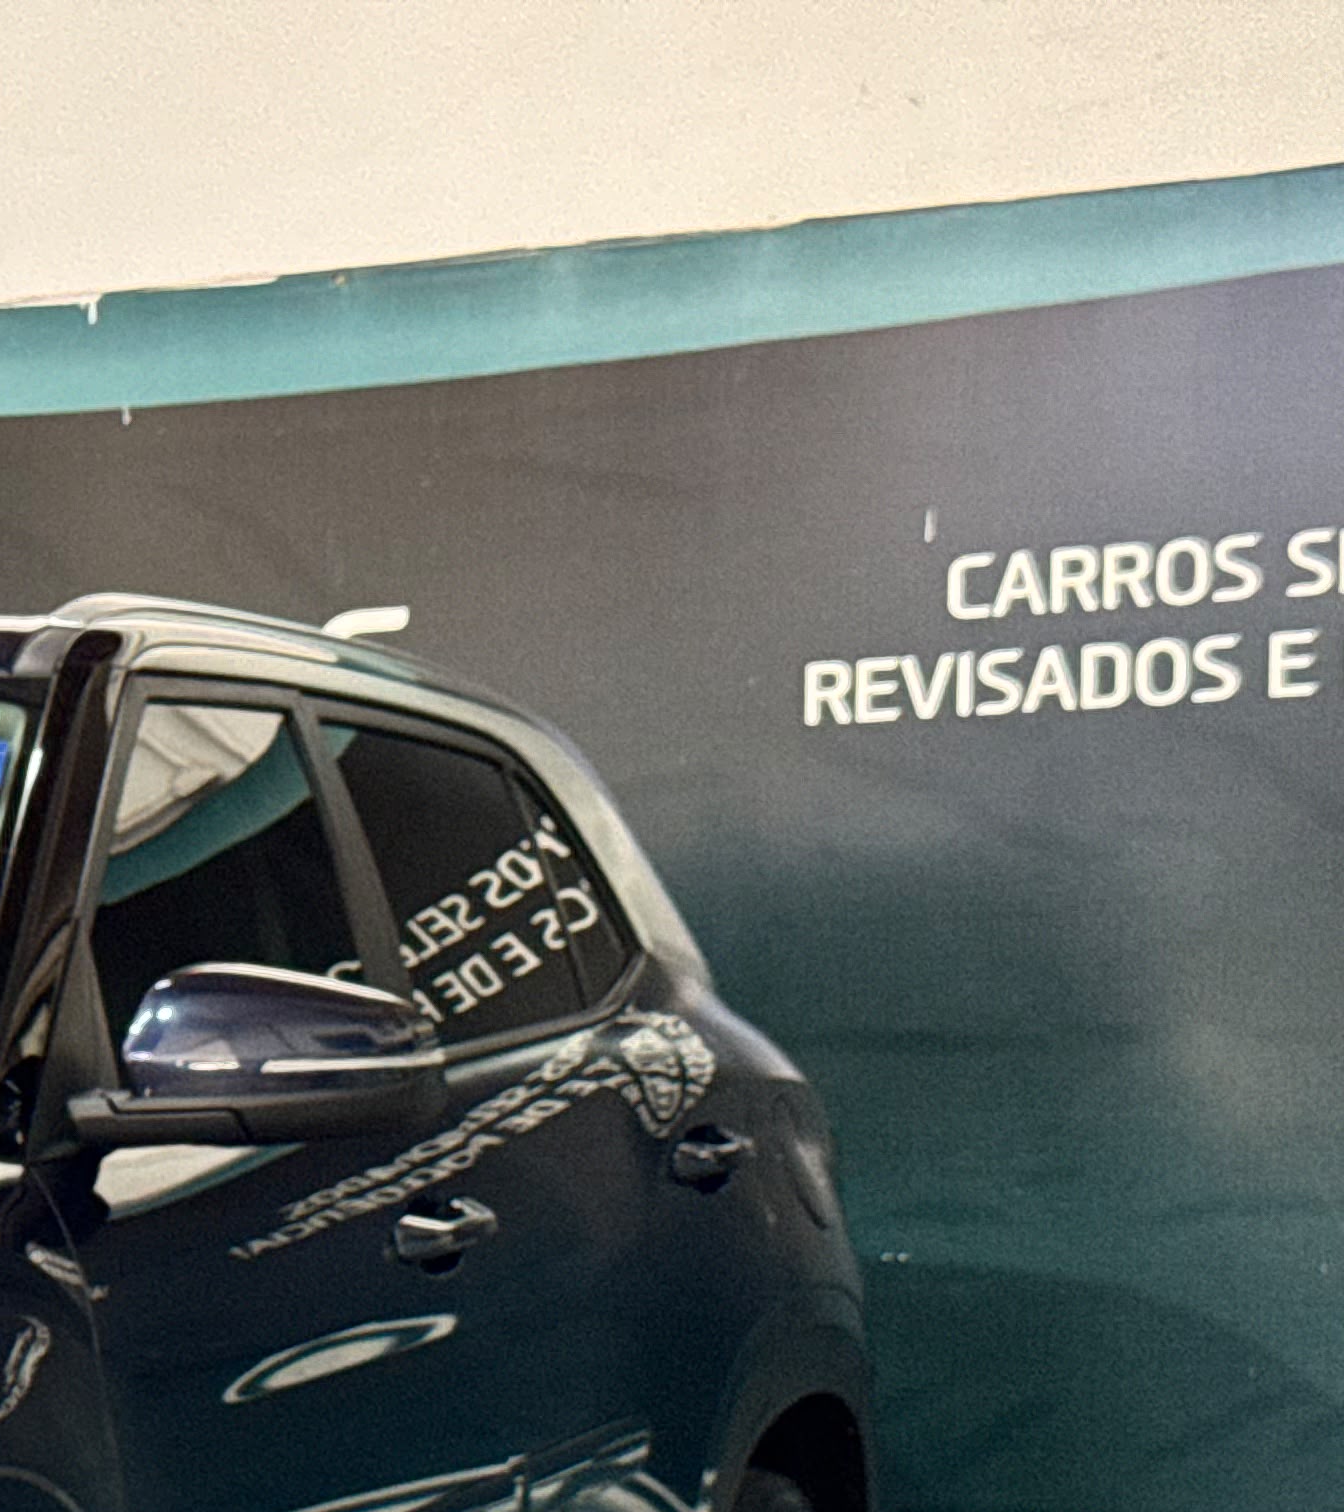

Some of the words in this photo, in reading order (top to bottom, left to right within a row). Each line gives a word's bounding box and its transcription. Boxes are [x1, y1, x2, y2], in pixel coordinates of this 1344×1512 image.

[946, 531, 1264, 621] CARROS
[1285, 527, 1344, 598] S
[803, 633, 1242, 727] REVISADOS
[1267, 628, 1319, 699] E
